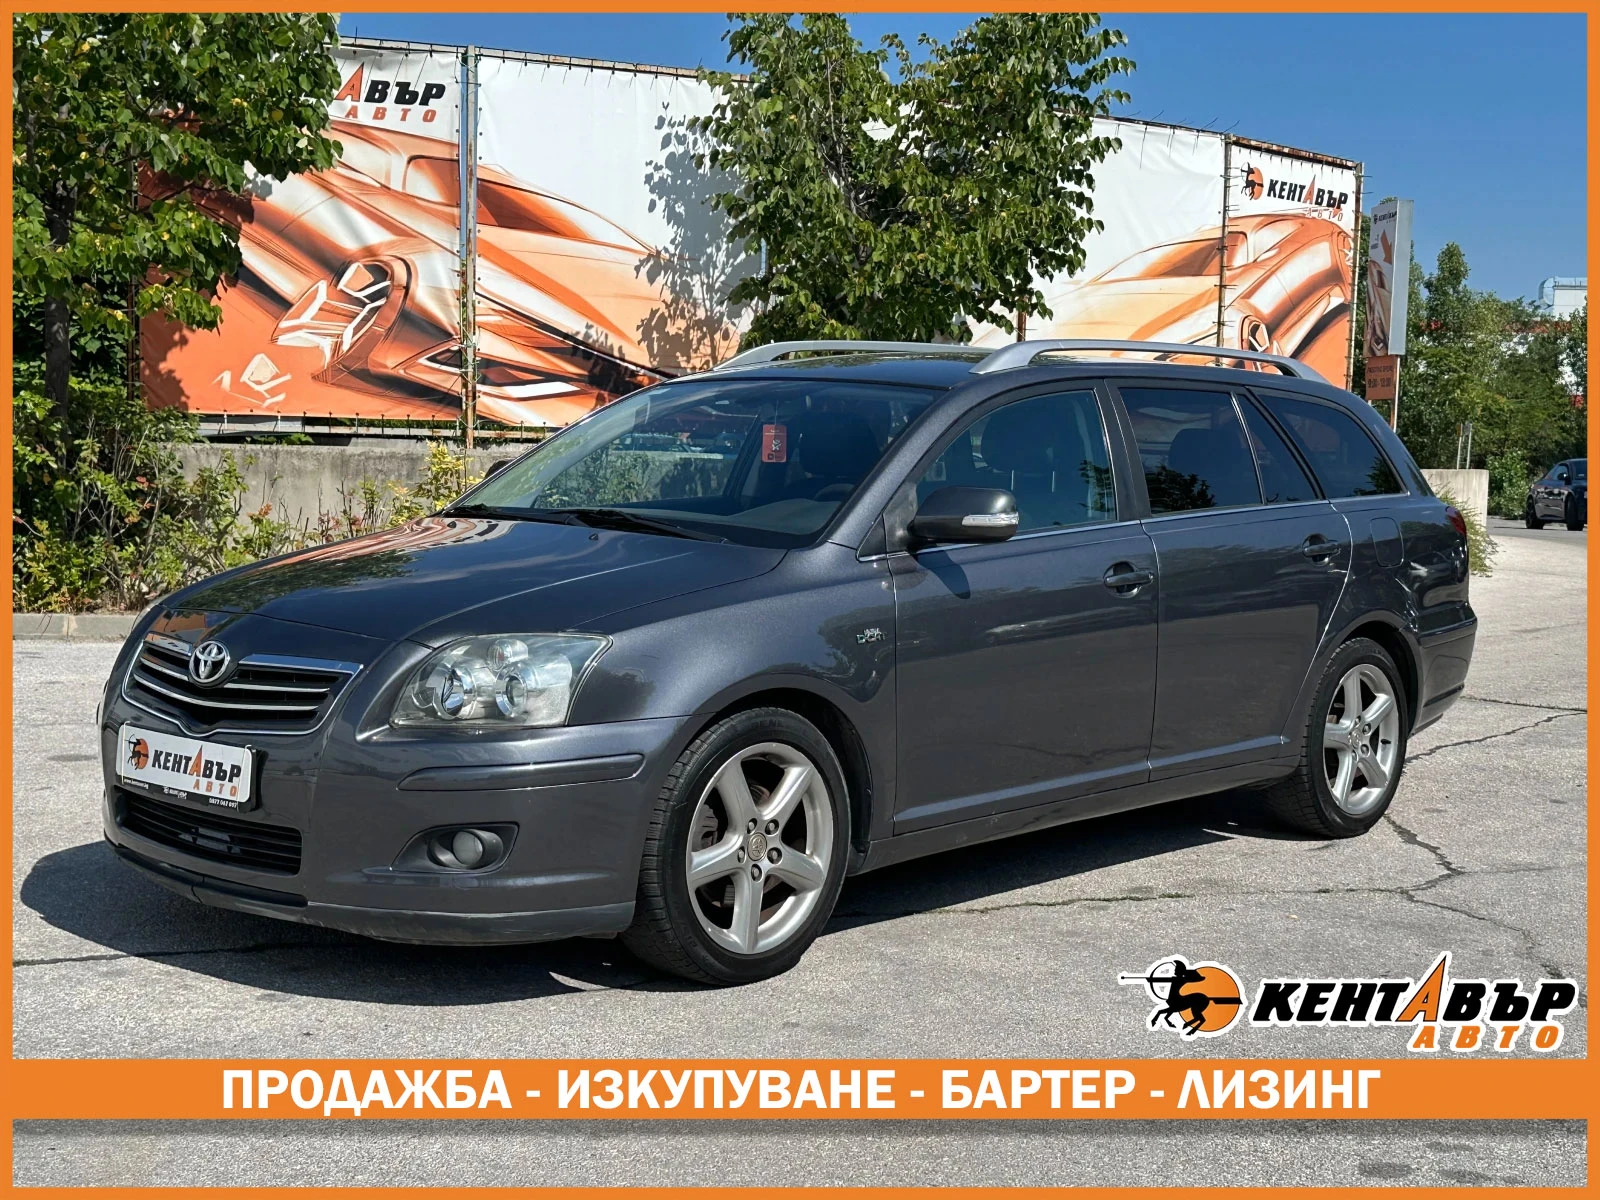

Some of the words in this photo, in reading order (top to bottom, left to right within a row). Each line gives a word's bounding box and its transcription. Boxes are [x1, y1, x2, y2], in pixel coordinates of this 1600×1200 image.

[334, 61, 446, 107] АВЪР
[344, 104, 437, 123] АВТО
[1266, 174, 1349, 210] КЕНТАВЪР
[151, 744, 242, 783] КЕНТАВЪР
[193, 778, 238, 797] АВТО
